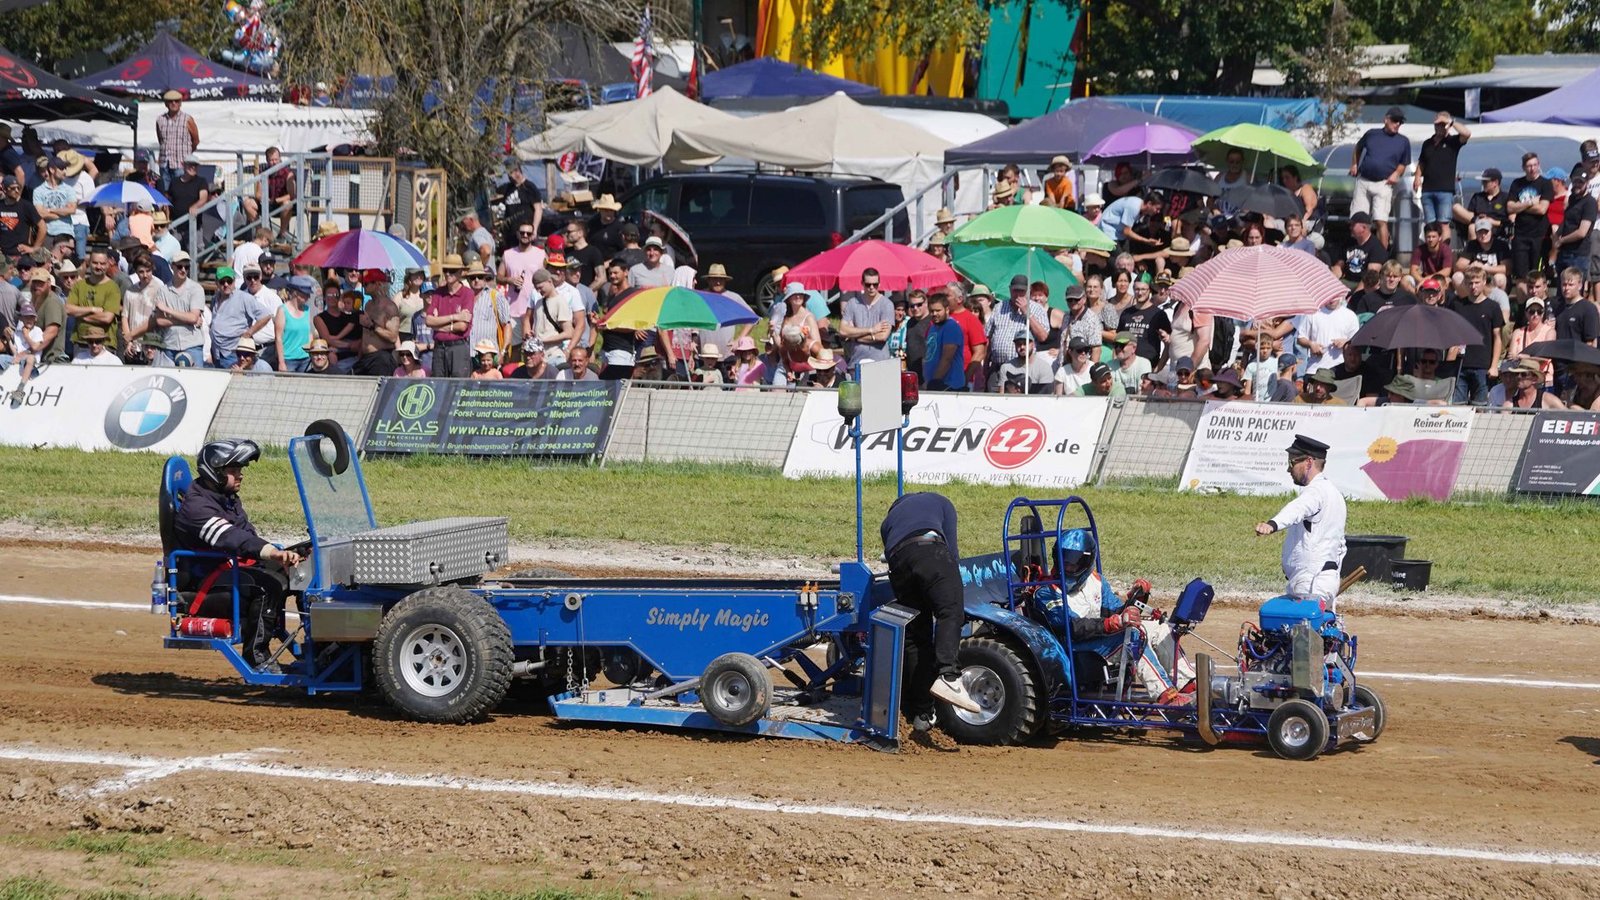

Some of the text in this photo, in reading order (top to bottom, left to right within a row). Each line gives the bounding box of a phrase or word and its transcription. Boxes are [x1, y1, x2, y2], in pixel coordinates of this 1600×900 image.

[120, 375, 186, 403] BMW
[460, 389, 513, 397] Baumaschinen
[555, 389, 608, 398] Neumaschinen
[456, 400, 513, 408] Landmaschinen
[552, 400, 613, 409] Reparaturservice
[492, 411, 538, 420] Gartengeräte
[549, 410, 581, 419] Mietpark
[375, 419, 439, 433] HAAS
[1209, 415, 1296, 431] DANN PACKEN
[1413, 418, 1469, 429] Reiner Kunz
[1541, 419, 1600, 435] EBER
[449, 424, 599, 436] www.haas-maschinen.de
[1206, 428, 1268, 443] WIR'S AN!
[989, 427, 1039, 454] 12
[917, 471, 980, 482] SPORTWAGEN
[990, 473, 1042, 483] WERKSTATT
[1053, 475, 1077, 485] TEILE
[646, 606, 769, 632] Simply Magic
